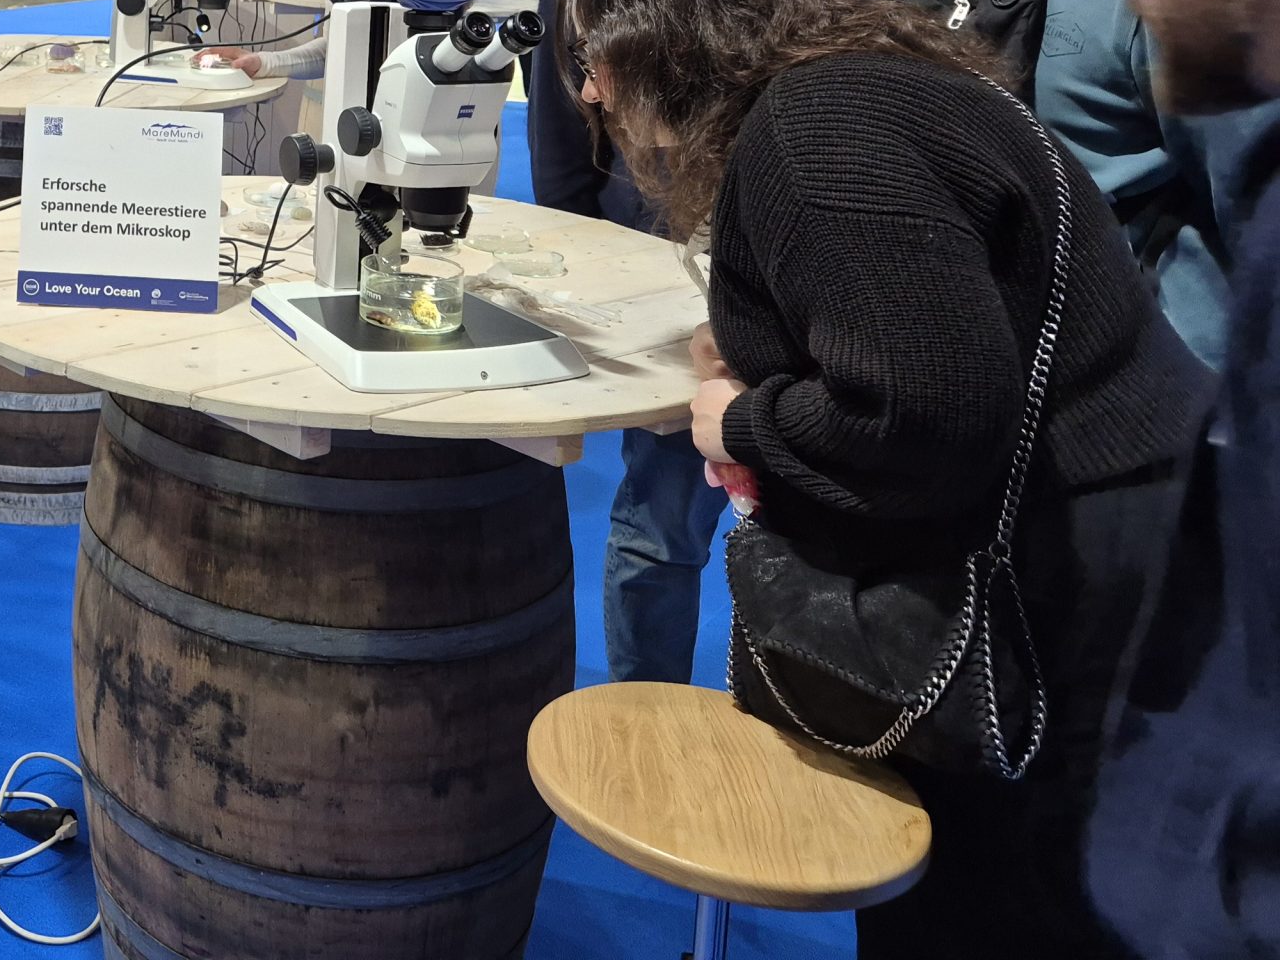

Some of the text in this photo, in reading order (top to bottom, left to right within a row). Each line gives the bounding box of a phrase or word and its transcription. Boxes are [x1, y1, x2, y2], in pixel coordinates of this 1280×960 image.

[141, 127, 203, 139] MareMundi
[42, 177, 107, 193] Erforsche
[40, 200, 207, 219] spannende Meerestiere
[40, 220, 191, 241] unter dem Mikroskop
[45, 282, 141, 298] Love Your Ocean
